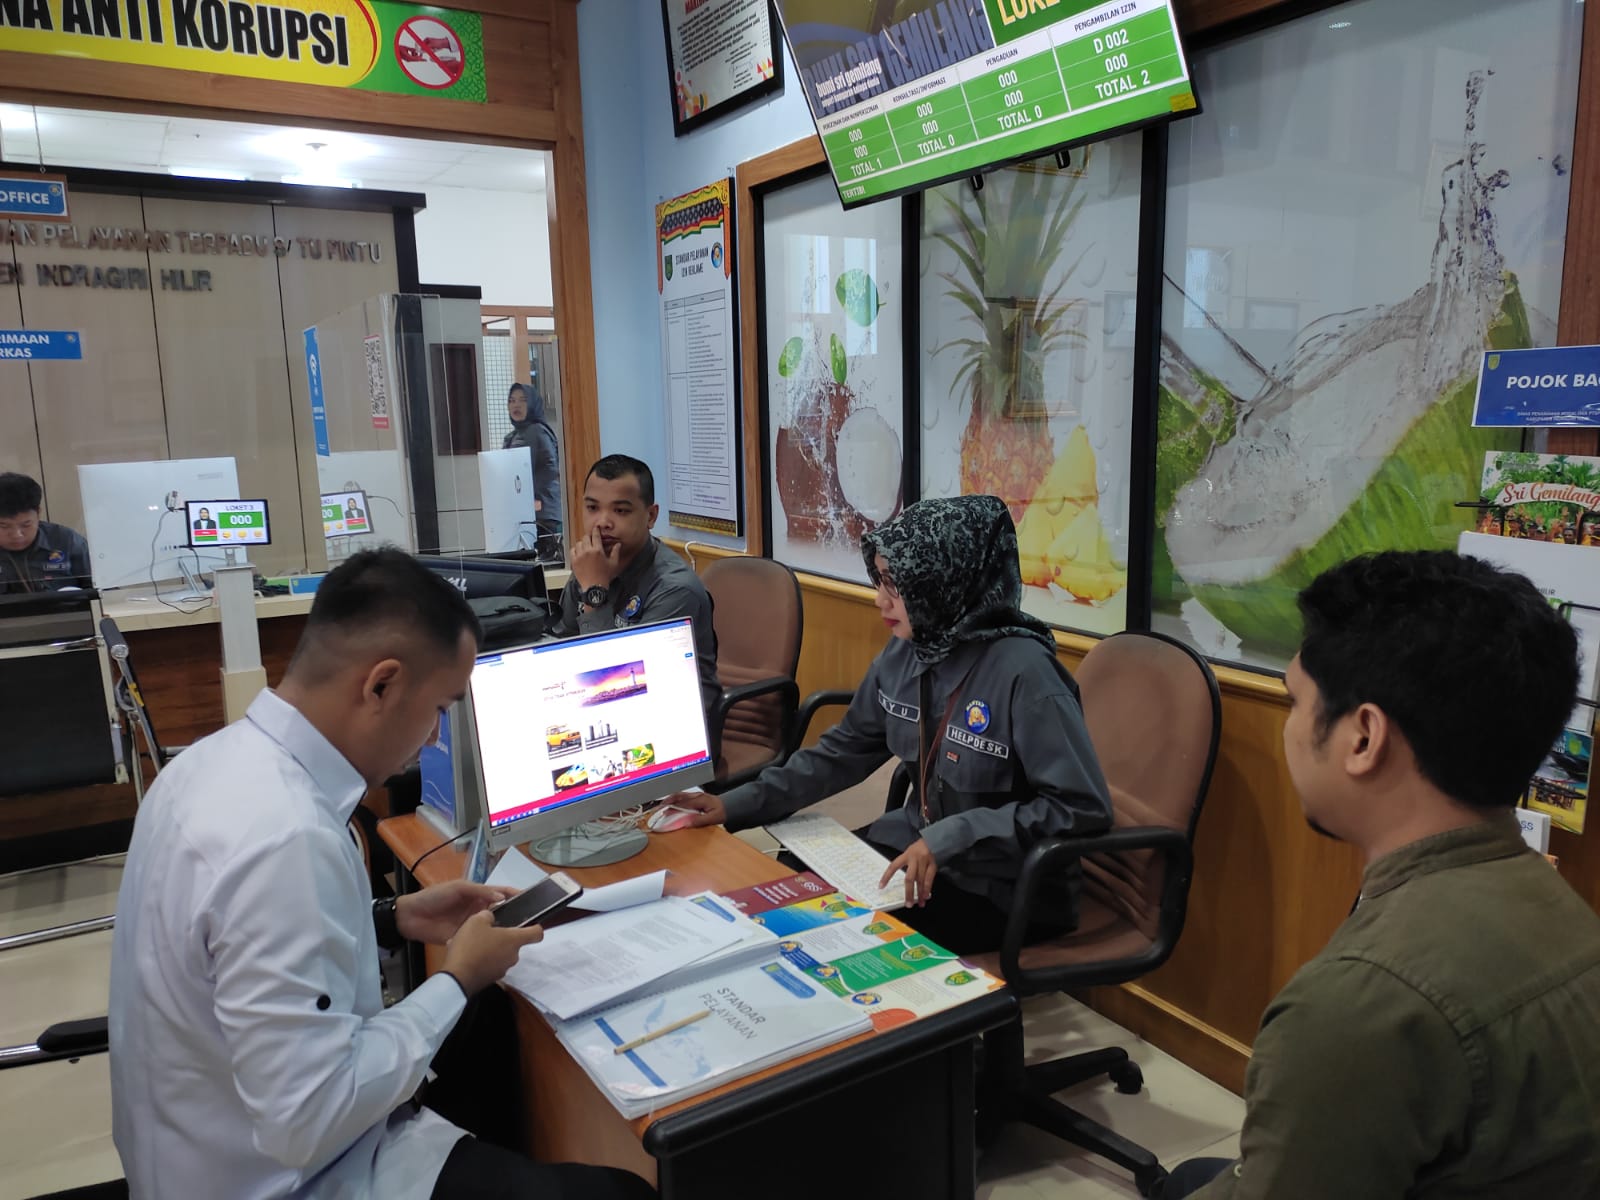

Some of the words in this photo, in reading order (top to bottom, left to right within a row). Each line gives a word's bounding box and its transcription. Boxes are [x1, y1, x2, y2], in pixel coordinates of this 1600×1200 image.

[1073, 8, 1121, 33] PENGAMBILAN
[1119, 2, 1138, 16] IZIN
[62, 0, 163, 44] ANTI
[172, 0, 350, 67] KORUPSI
[1093, 38, 1104, 55] D
[1105, 28, 1130, 46] 002
[985, 48, 1018, 68] PENGADUAN
[1104, 52, 1129, 74] 000
[998, 69, 1019, 89] 000
[1094, 75, 1137, 100] TOTAL
[1141, 69, 1151, 86] 2
[1004, 89, 1024, 109] 000
[916, 102, 934, 119] 000
[997, 110, 1032, 132] TOTAL
[1034, 104, 1043, 120] 0
[848, 128, 863, 144] 000
[922, 119, 940, 136] 000
[853, 144, 869, 159] 000
[917, 137, 947, 157] TOTAL
[948, 133, 956, 148] 0
[850, 160, 876, 178] TOTAL
[876, 157, 883, 170] 1
[0, 189, 50, 205] OFFICE
[0, 223, 37, 247] AN
[160, 268, 213, 292] HILIR
[0, 333, 50, 346] IMAAN
[1506, 374, 1569, 389] POJOK
[1503, 484, 1525, 504] Sri
[230, 515, 252, 525] 000
[717, 986, 767, 1026] STANDAR
[699, 992, 758, 1041] PELAYANAN
